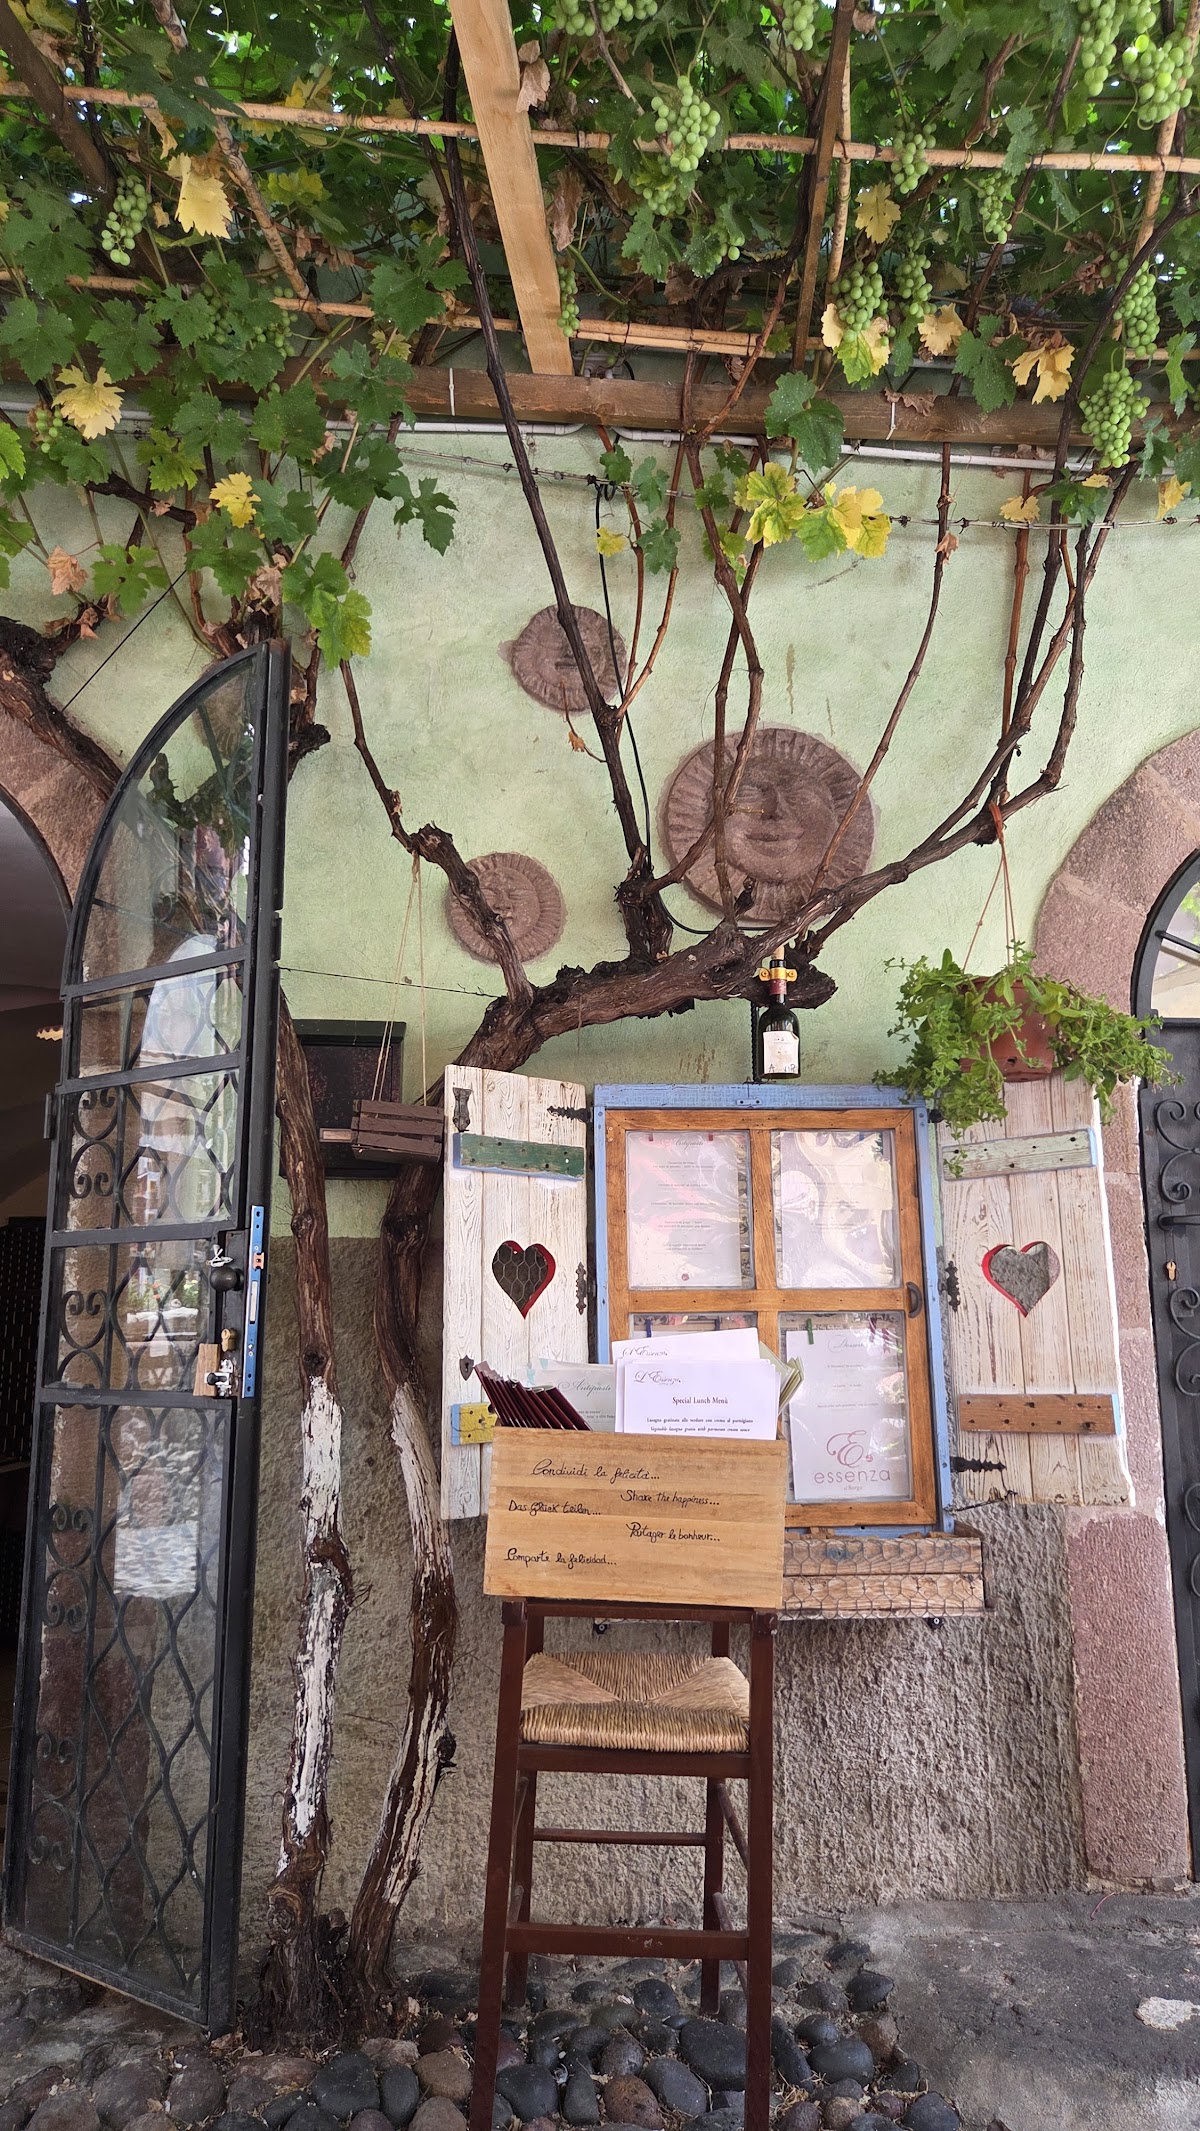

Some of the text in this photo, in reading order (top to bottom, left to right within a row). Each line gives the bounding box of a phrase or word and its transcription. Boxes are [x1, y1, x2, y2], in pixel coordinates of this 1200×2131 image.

[558, 1379, 612, 1397] Antipasti
[672, 1396, 692, 1405] Special
[693, 1396, 711, 1404] Lunch
[531, 1458, 588, 1477] Condividi
[594, 1466, 608, 1477] la
[814, 1469, 891, 1484] essenza
[620, 1489, 653, 1502] Share
[656, 1491, 670, 1503] the
[508, 1499, 527, 1512] Das
[668, 1529, 676, 1540] le
[504, 1547, 550, 1568] Comparte
[555, 1552, 567, 1564] la
